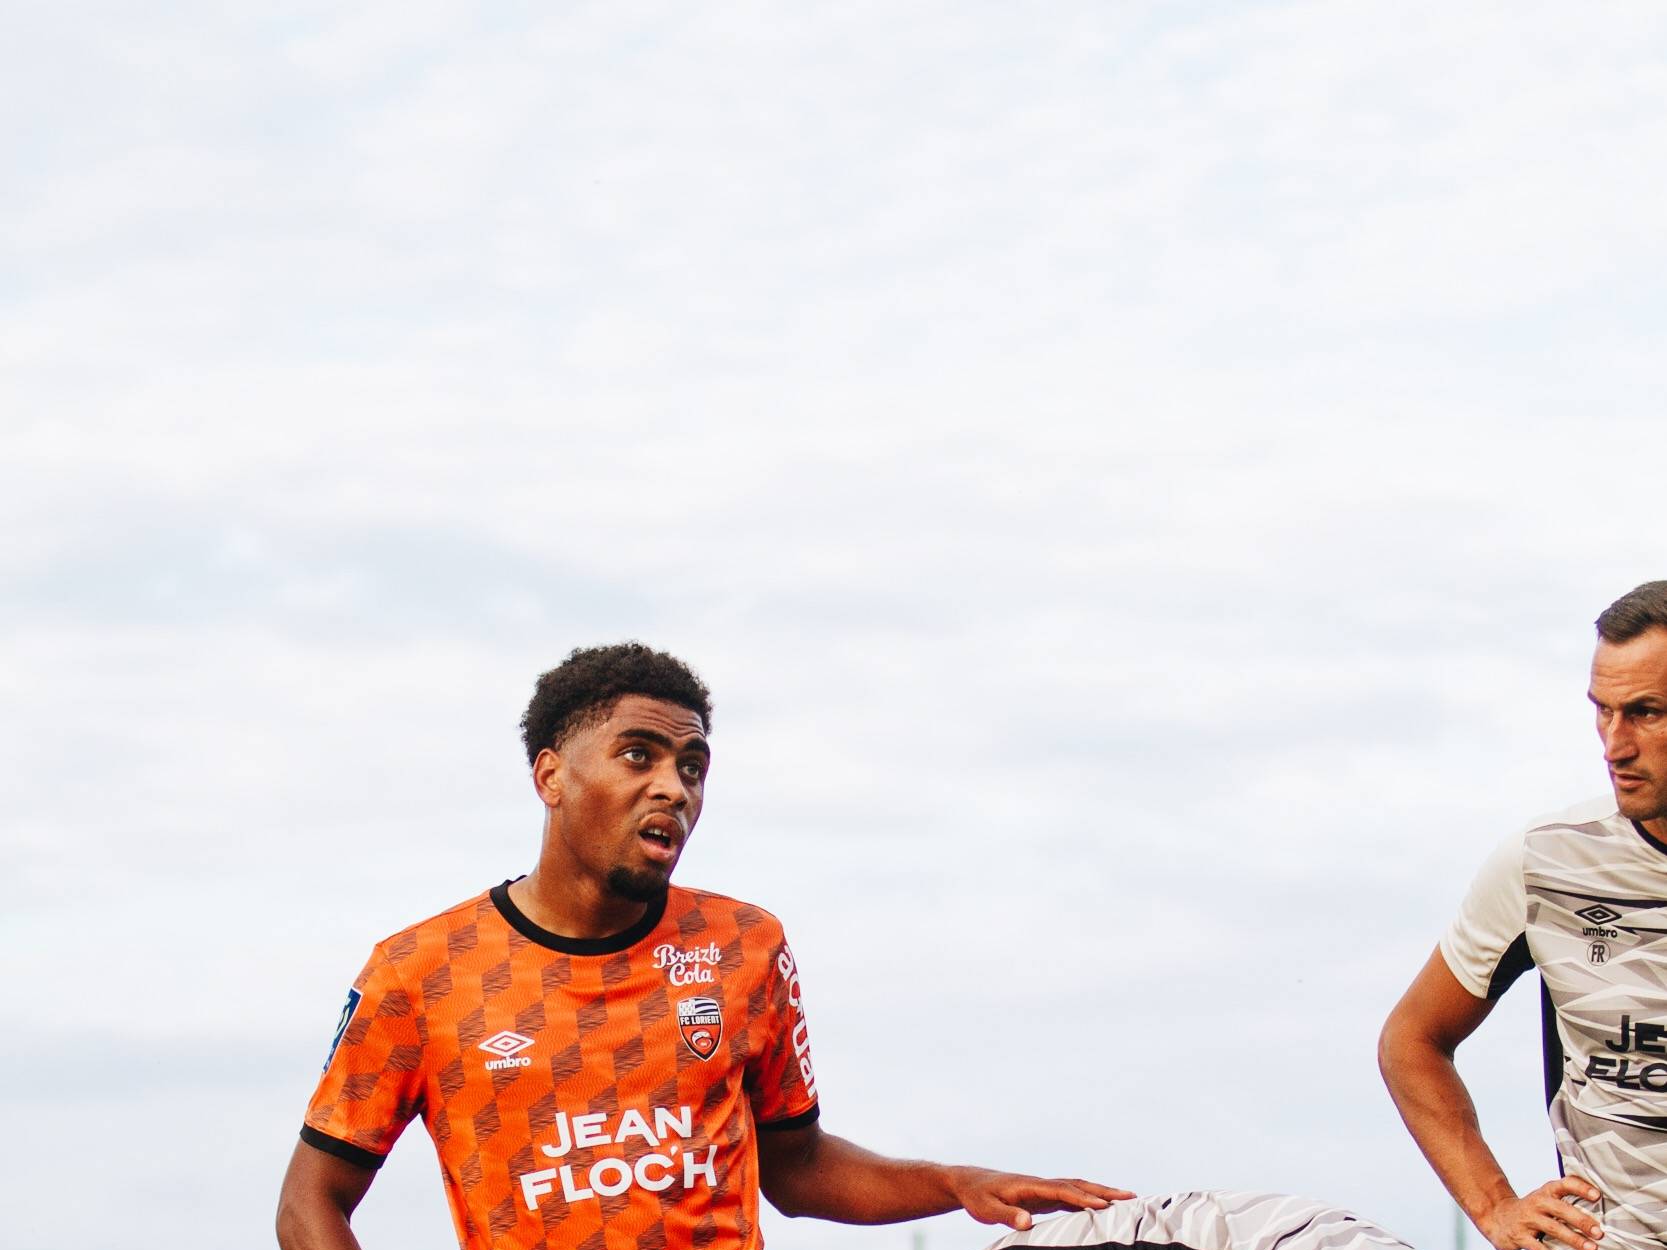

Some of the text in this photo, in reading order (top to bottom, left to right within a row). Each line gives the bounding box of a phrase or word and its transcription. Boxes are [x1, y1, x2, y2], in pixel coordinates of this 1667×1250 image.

[1582, 927, 1618, 938] umbro
[652, 942, 722, 968] Breizh
[1591, 945, 1605, 962] FR
[669, 963, 714, 986] Cola
[680, 1015, 719, 1025] FC LORIENT
[1605, 1015, 1667, 1053] JE
[485, 1056, 531, 1070] umbro
[1585, 1055, 1667, 1092] FLO
[541, 1106, 692, 1157] JEAN
[519, 1144, 718, 1211] FLOC'H
